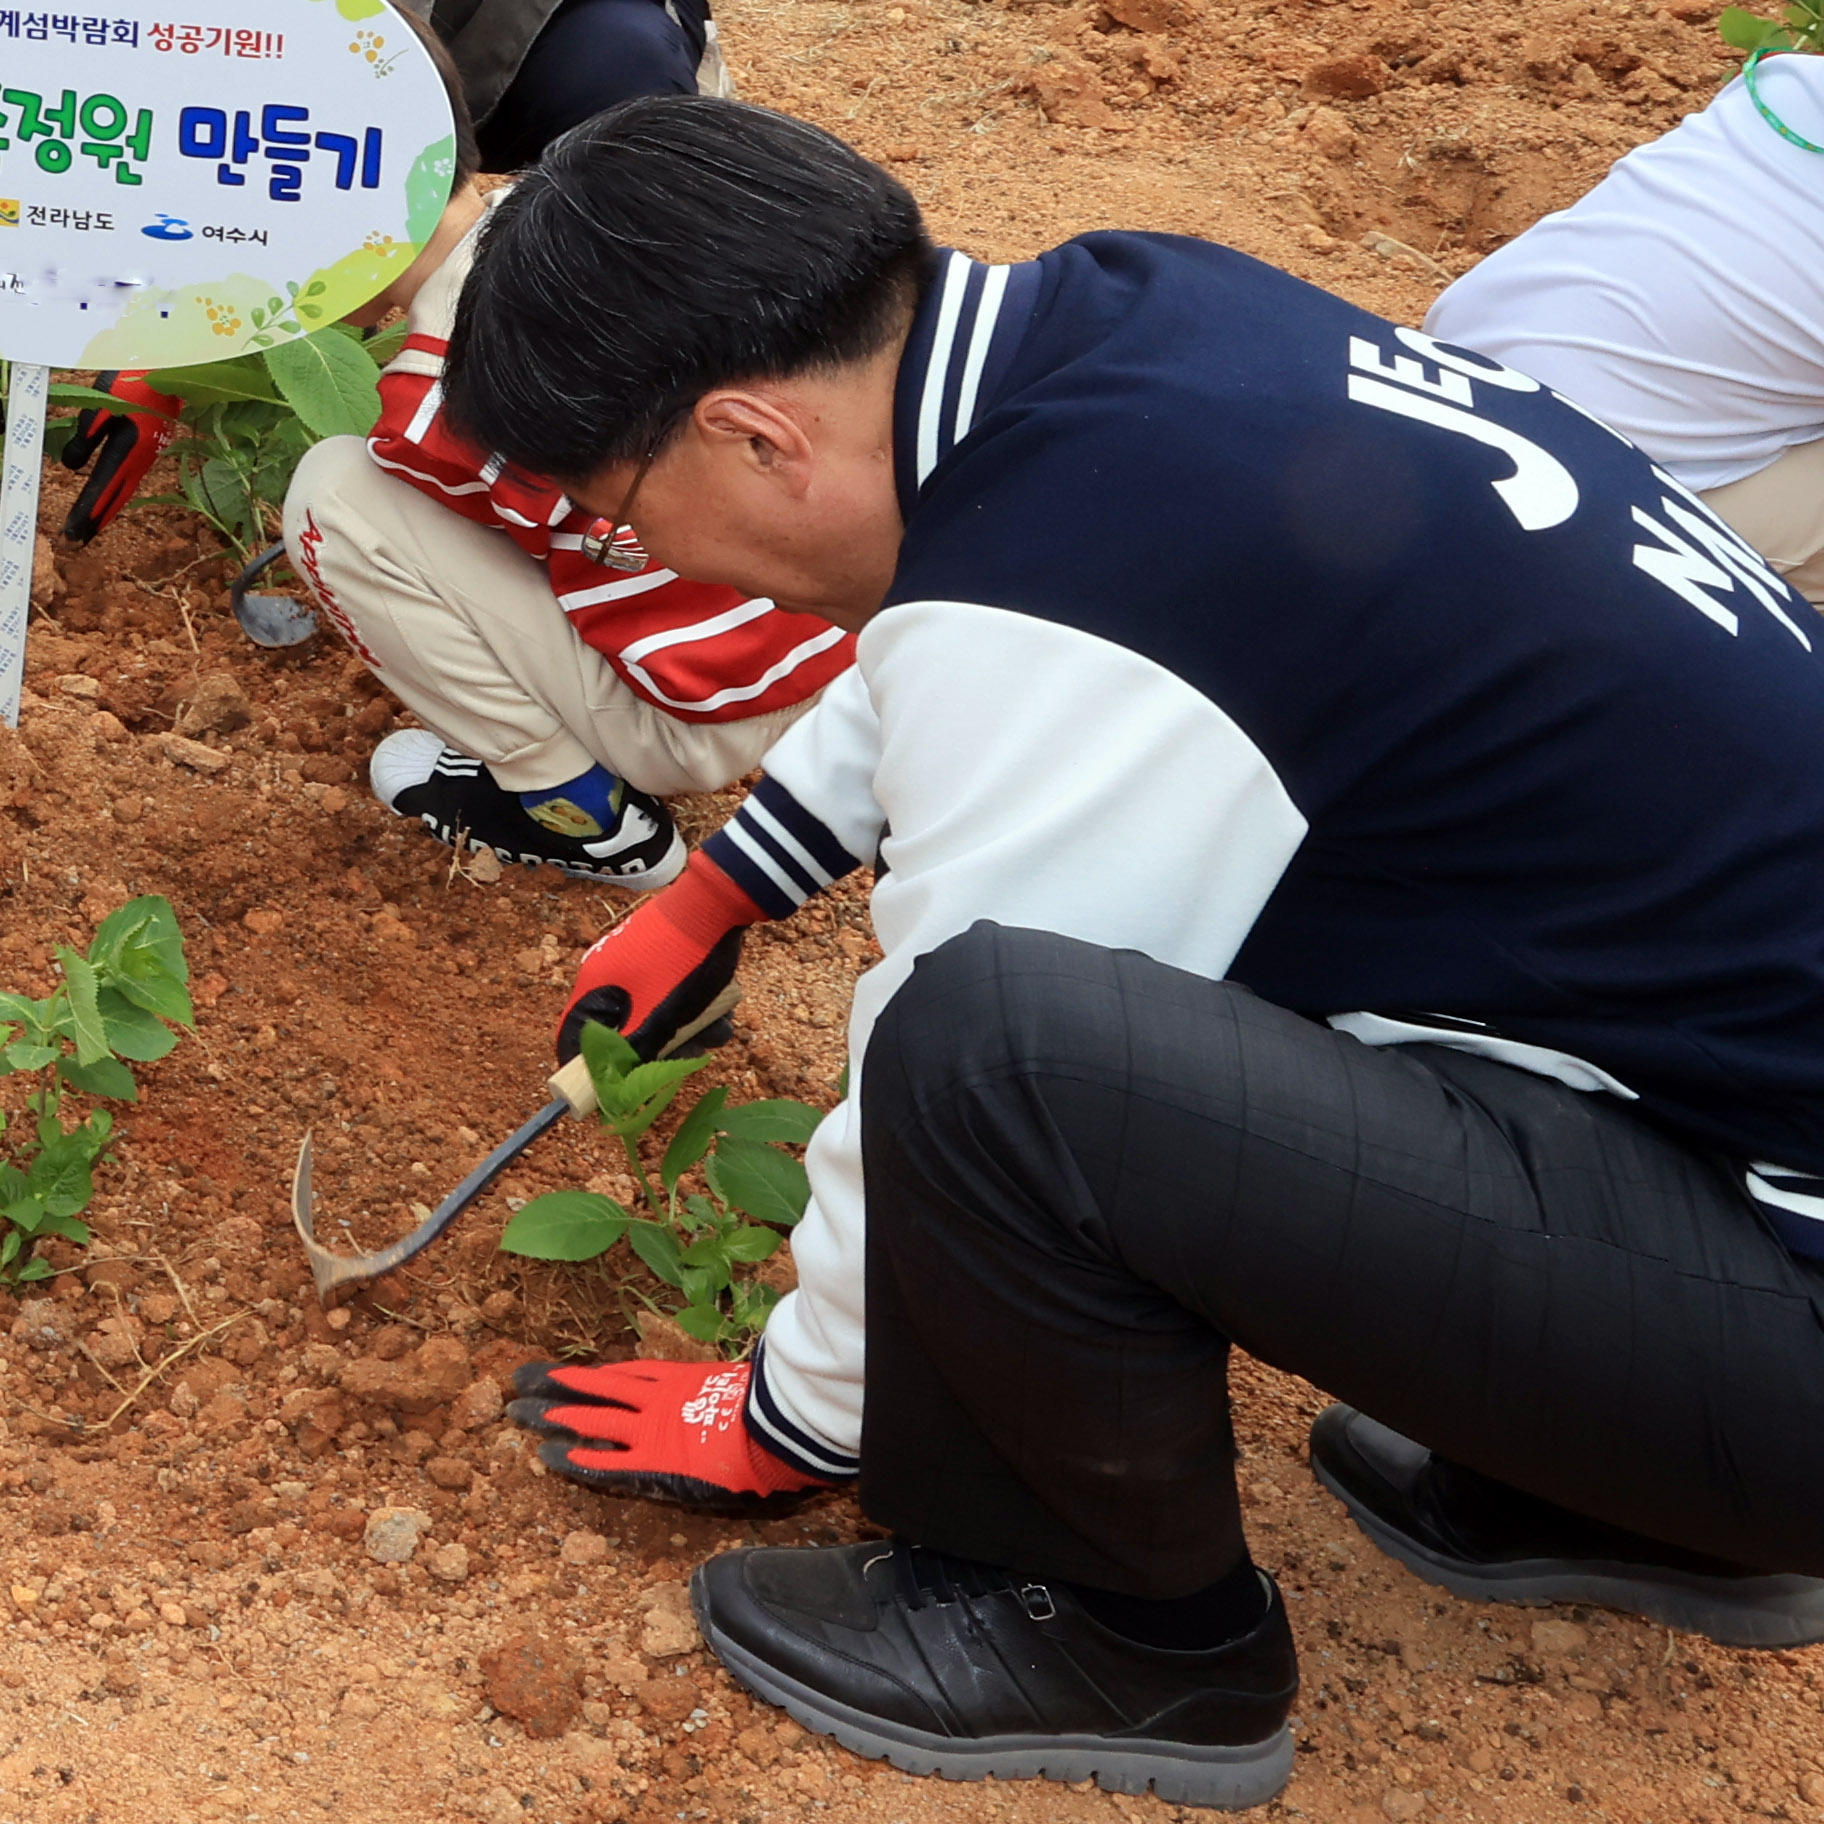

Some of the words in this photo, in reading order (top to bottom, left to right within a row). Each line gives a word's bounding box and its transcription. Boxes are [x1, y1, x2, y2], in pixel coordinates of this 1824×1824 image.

[147, 22, 285, 61] 성공기원!!
[179, 103, 384, 203] 만들기
[26, 204, 116, 233] 전라남도
[202, 225, 270, 248] 여수시
